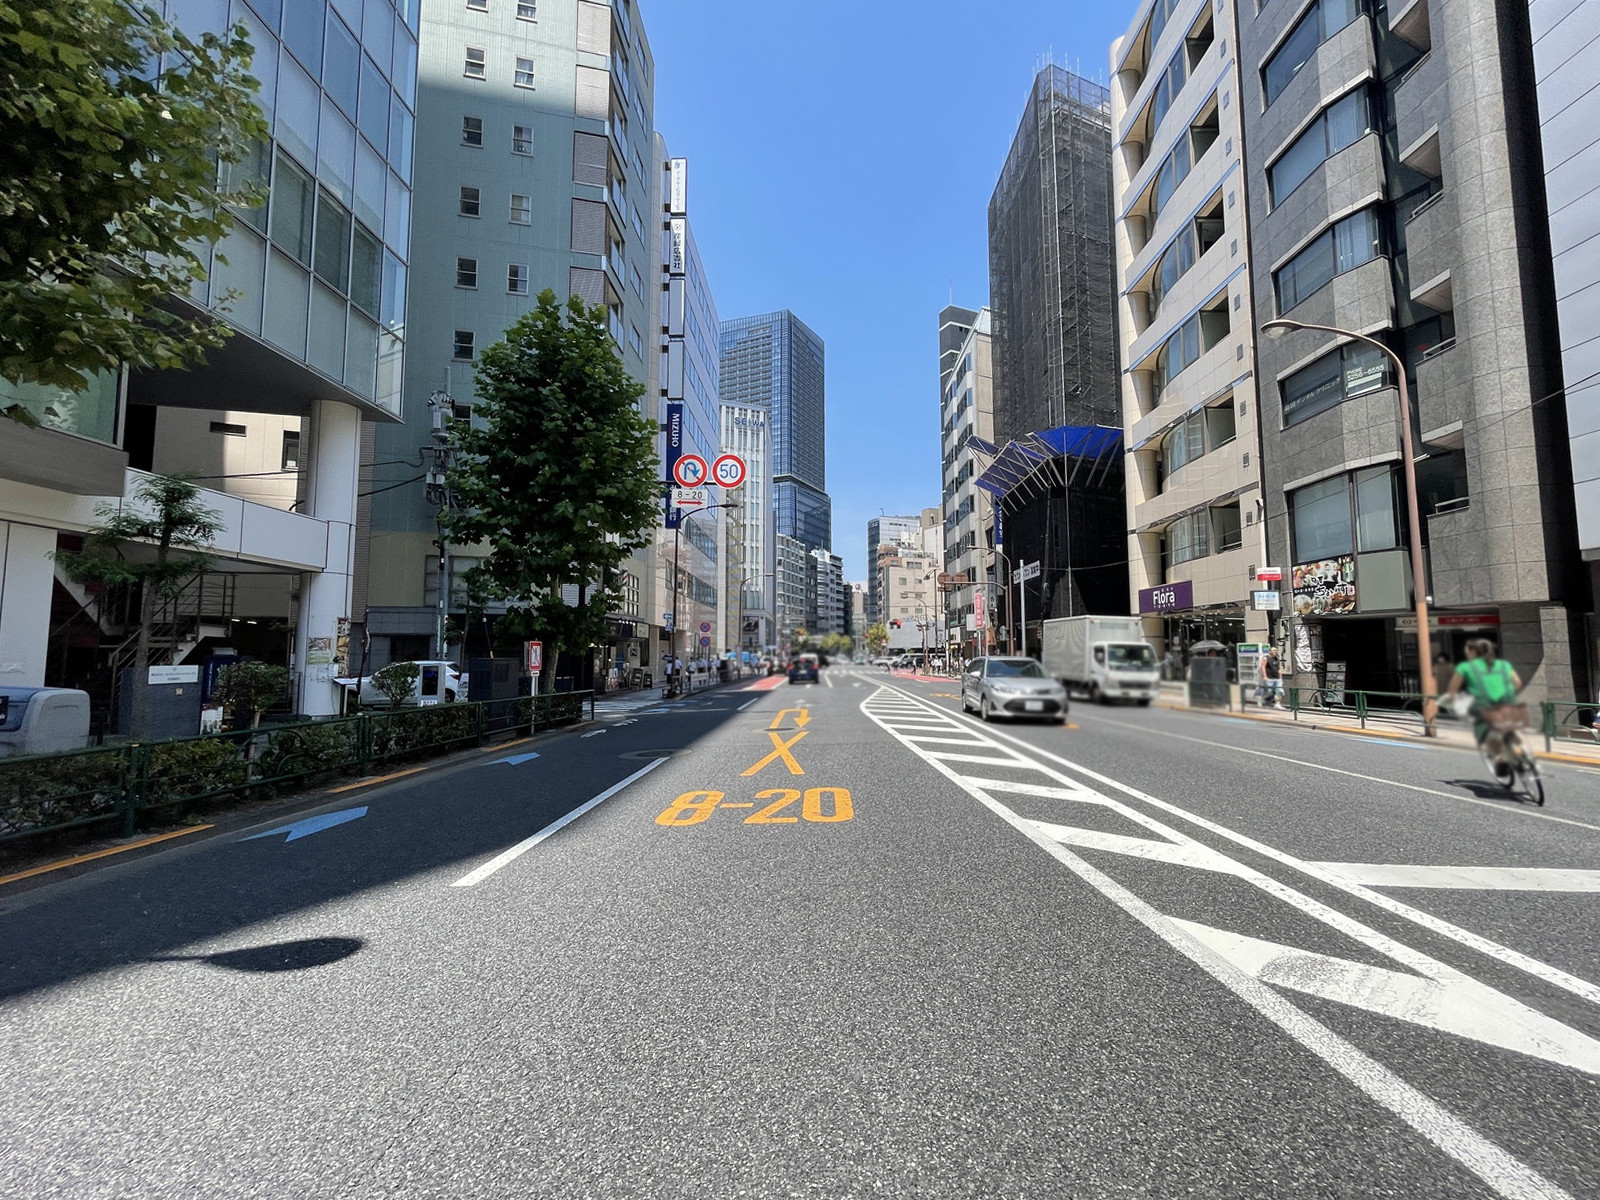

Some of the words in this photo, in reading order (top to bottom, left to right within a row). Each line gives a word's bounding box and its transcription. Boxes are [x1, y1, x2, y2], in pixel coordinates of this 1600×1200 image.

[734, 416, 765, 427] SEIWA
[671, 412, 680, 448] MIZUHO
[719, 463, 739, 479] 50
[1153, 590, 1175, 605] Flora
[654, 787, 854, 827] 8-20
